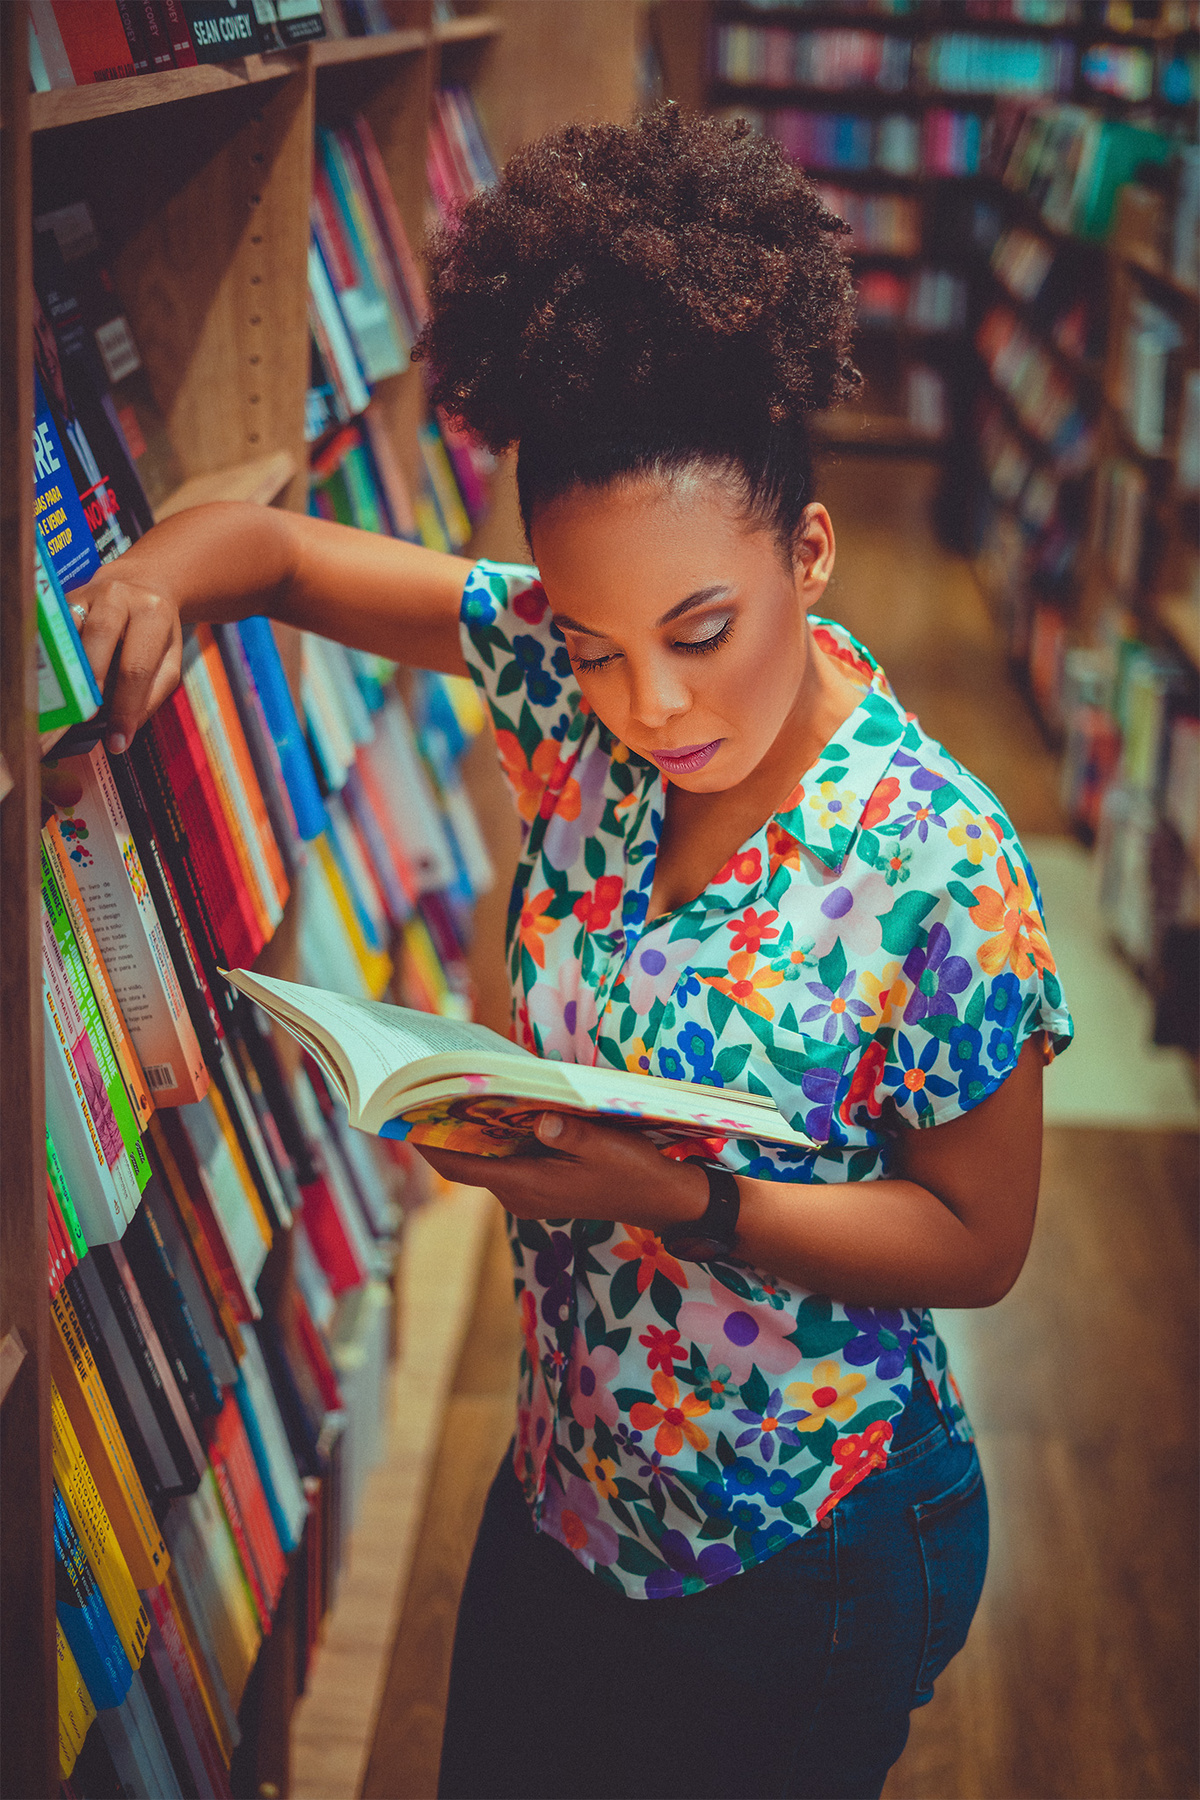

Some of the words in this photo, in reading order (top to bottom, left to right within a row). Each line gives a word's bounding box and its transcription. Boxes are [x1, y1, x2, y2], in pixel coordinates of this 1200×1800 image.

[122, 13, 136, 42] COVEY
[145, 6, 160, 37] COVEY
[193, 19, 221, 46] SEAN
[219, 13, 252, 41] COVEY
[33, 421, 61, 481] RE
[41, 518, 50, 535] E
[46, 507, 68, 531] VENDA
[44, 485, 63, 508] PARA
[47, 527, 73, 556] STARTUP
[95, 761, 104, 781] TIM
[102, 782, 118, 827] BROWN
[107, 775, 124, 819] BROWN
[41, 887, 57, 926] BORGES
[58, 939, 66, 950] A
[62, 952, 84, 1007] JORNADA
[81, 1008, 91, 1026] DA
[86, 1025, 112, 1091] LIBERDADE
[47, 877, 63, 917] BORGES
[64, 929, 72, 940] A
[68, 942, 90, 997] JORNADA
[86, 998, 96, 1016] DA
[92, 1015, 118, 1080] LIBERDADE
[49, 934, 66, 976] SONHOS
[63, 975, 69, 986] DE
[66, 986, 81, 1023] MATEUS
[70, 897, 97, 963] AVENTURAS
[93, 963, 124, 1043] EMPRESARIAIS
[54, 984, 61, 996] DE
[58, 997, 74, 1035] MATEUS
[45, 991, 56, 1013] UM
[52, 1012, 66, 1046] NOVO
[63, 1046, 77, 1081] JEITO
[74, 1080, 83, 1099] DE
[79, 1098, 105, 1167] TRABALHAR
[57, 1174, 70, 1202] Braga
[57, 1284, 71, 1311] ALE
[67, 1310, 96, 1371] CARNEGIE
[59, 1320, 89, 1383] CARNEGIE
[55, 1511, 71, 1549] importa
[73, 1551, 85, 1576] SEU
[59, 1501, 74, 1538] importa
[67, 1562, 79, 1587] SEU
[75, 1587, 94, 1630] resultado
